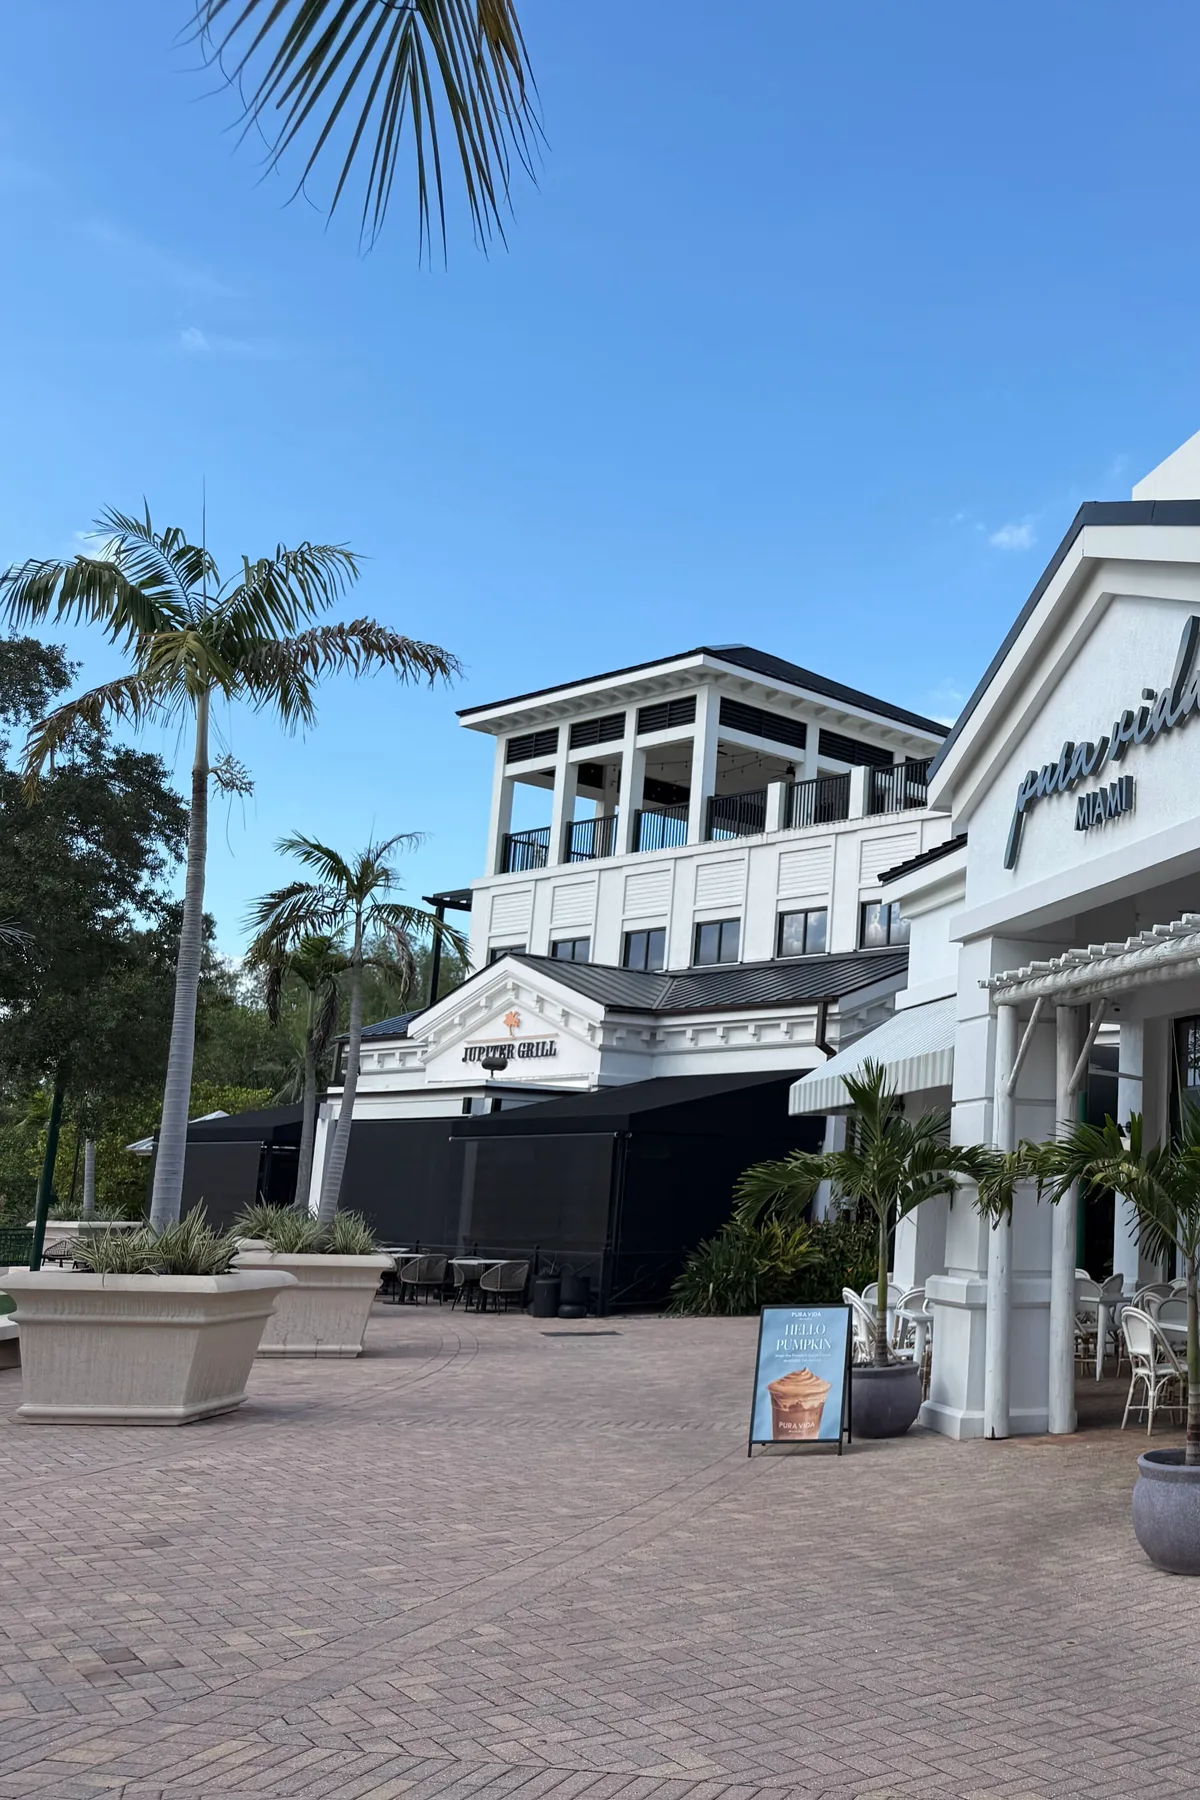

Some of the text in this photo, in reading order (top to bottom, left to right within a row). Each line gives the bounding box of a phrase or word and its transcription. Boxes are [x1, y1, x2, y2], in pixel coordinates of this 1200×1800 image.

[1004, 736, 1110, 870] pura
[1074, 775, 1134, 831] MIAMI
[462, 1040, 557, 1062] JUPITER GRILL
[785, 1324, 826, 1335] HELLO
[776, 1338, 831, 1350] PUMPKIN
[779, 1421, 815, 1429] PURA VIDA
